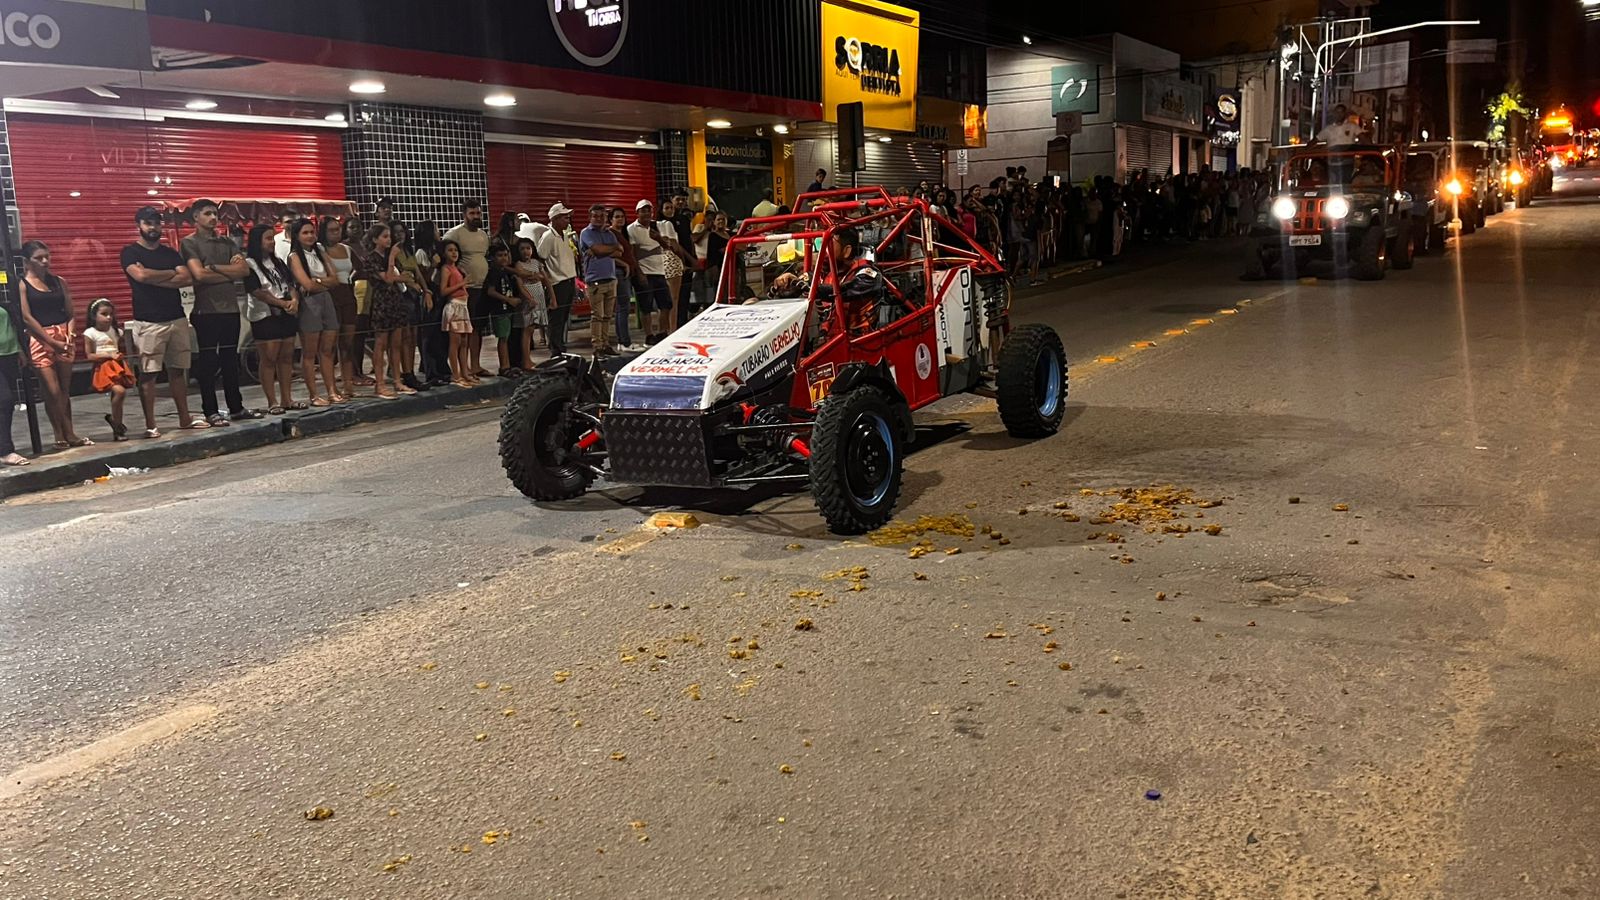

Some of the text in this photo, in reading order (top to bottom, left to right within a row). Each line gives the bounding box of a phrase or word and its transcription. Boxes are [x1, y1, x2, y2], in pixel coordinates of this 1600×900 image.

[835, 36, 901, 76] SORRIA
[629, 365, 709, 374] VERMELHO
[742, 322, 800, 377] TUBARÃO VERMELHO
